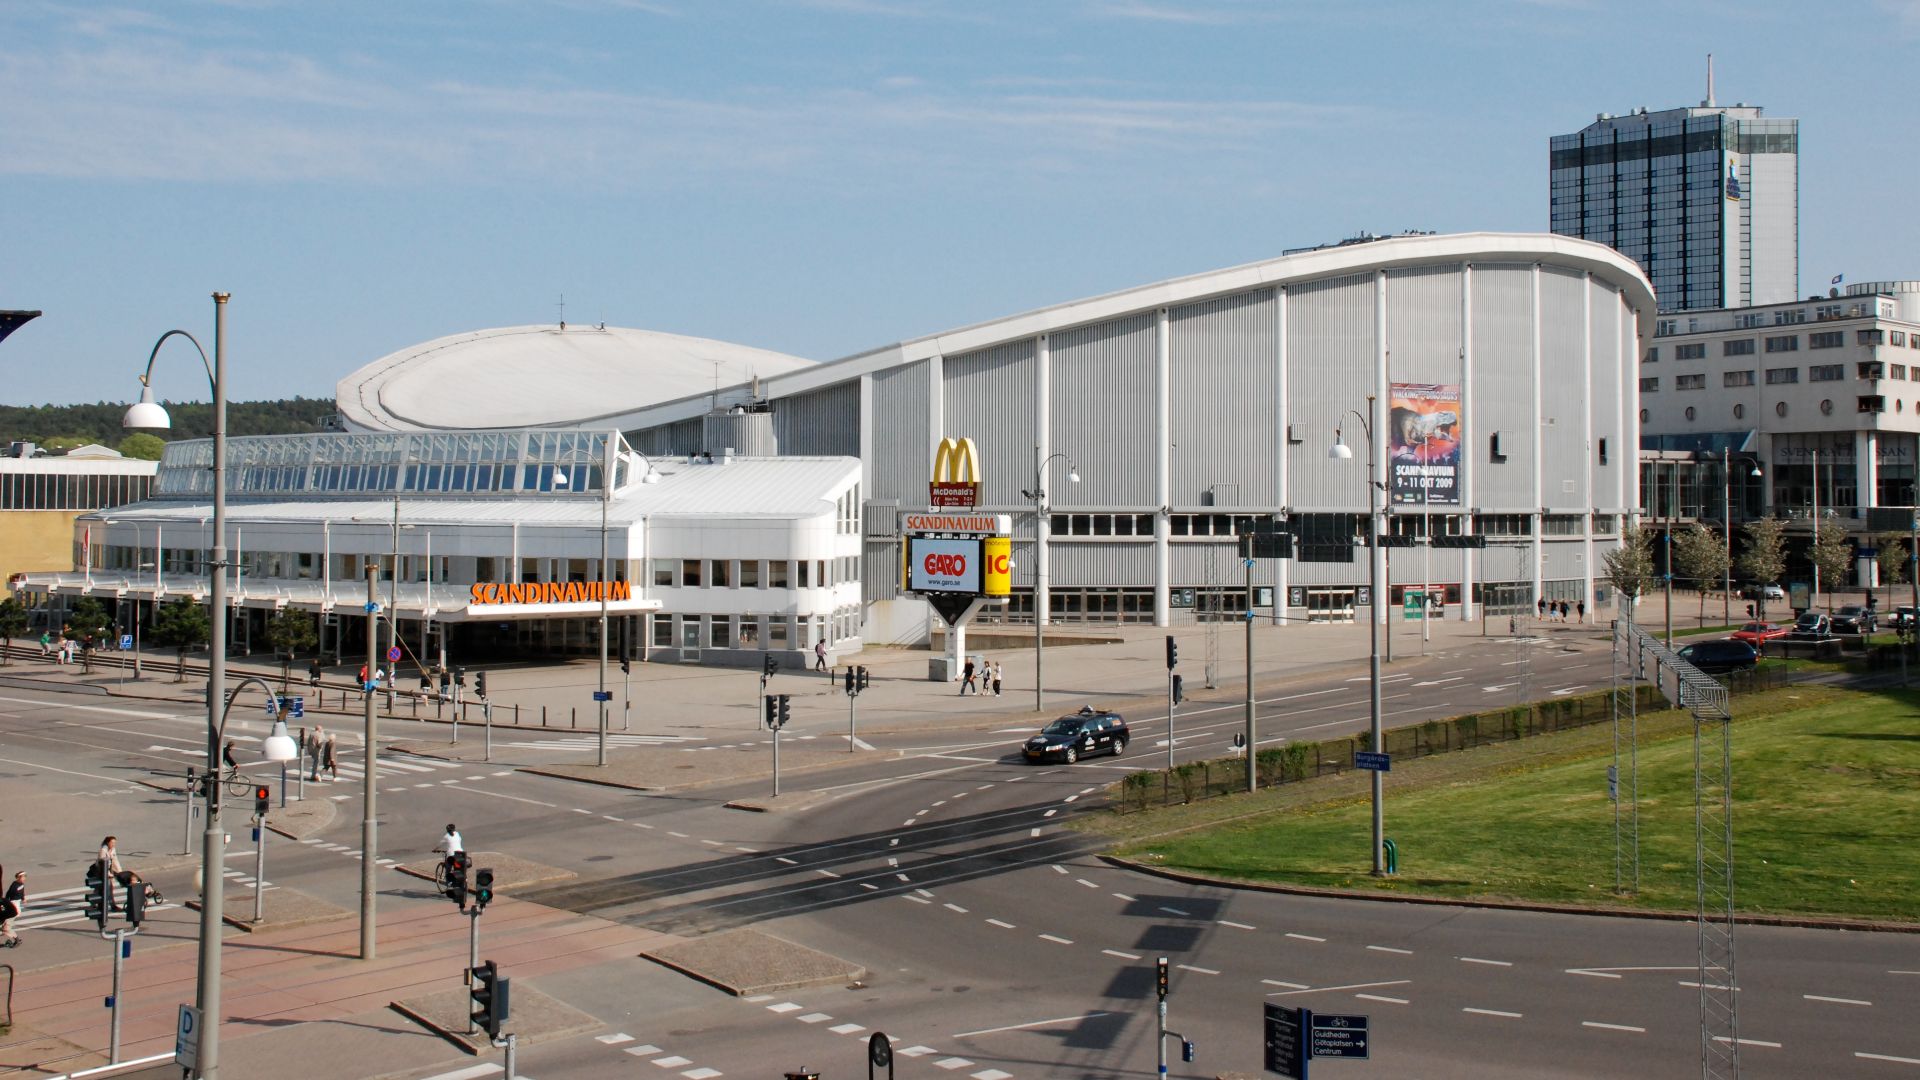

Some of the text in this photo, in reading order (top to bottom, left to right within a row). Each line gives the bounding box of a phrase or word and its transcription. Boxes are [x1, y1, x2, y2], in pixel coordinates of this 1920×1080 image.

[1396, 465, 1454, 476] SCANDAVIUM
[1397, 477, 1403, 487] 9
[1410, 477, 1418, 488] 11
[1435, 478, 1453, 488] 2009
[933, 488, 974, 496] McDonald's
[907, 516, 995, 531] SCANDINAVIUM
[924, 553, 966, 577] GARO
[471, 580, 631, 605] SCANDINAVIUM
[1315, 1031, 1350, 1039] Guldheden
[1315, 1039, 1354, 1047] Götaplatsen
[1315, 1047, 1342, 1055] Centrum
